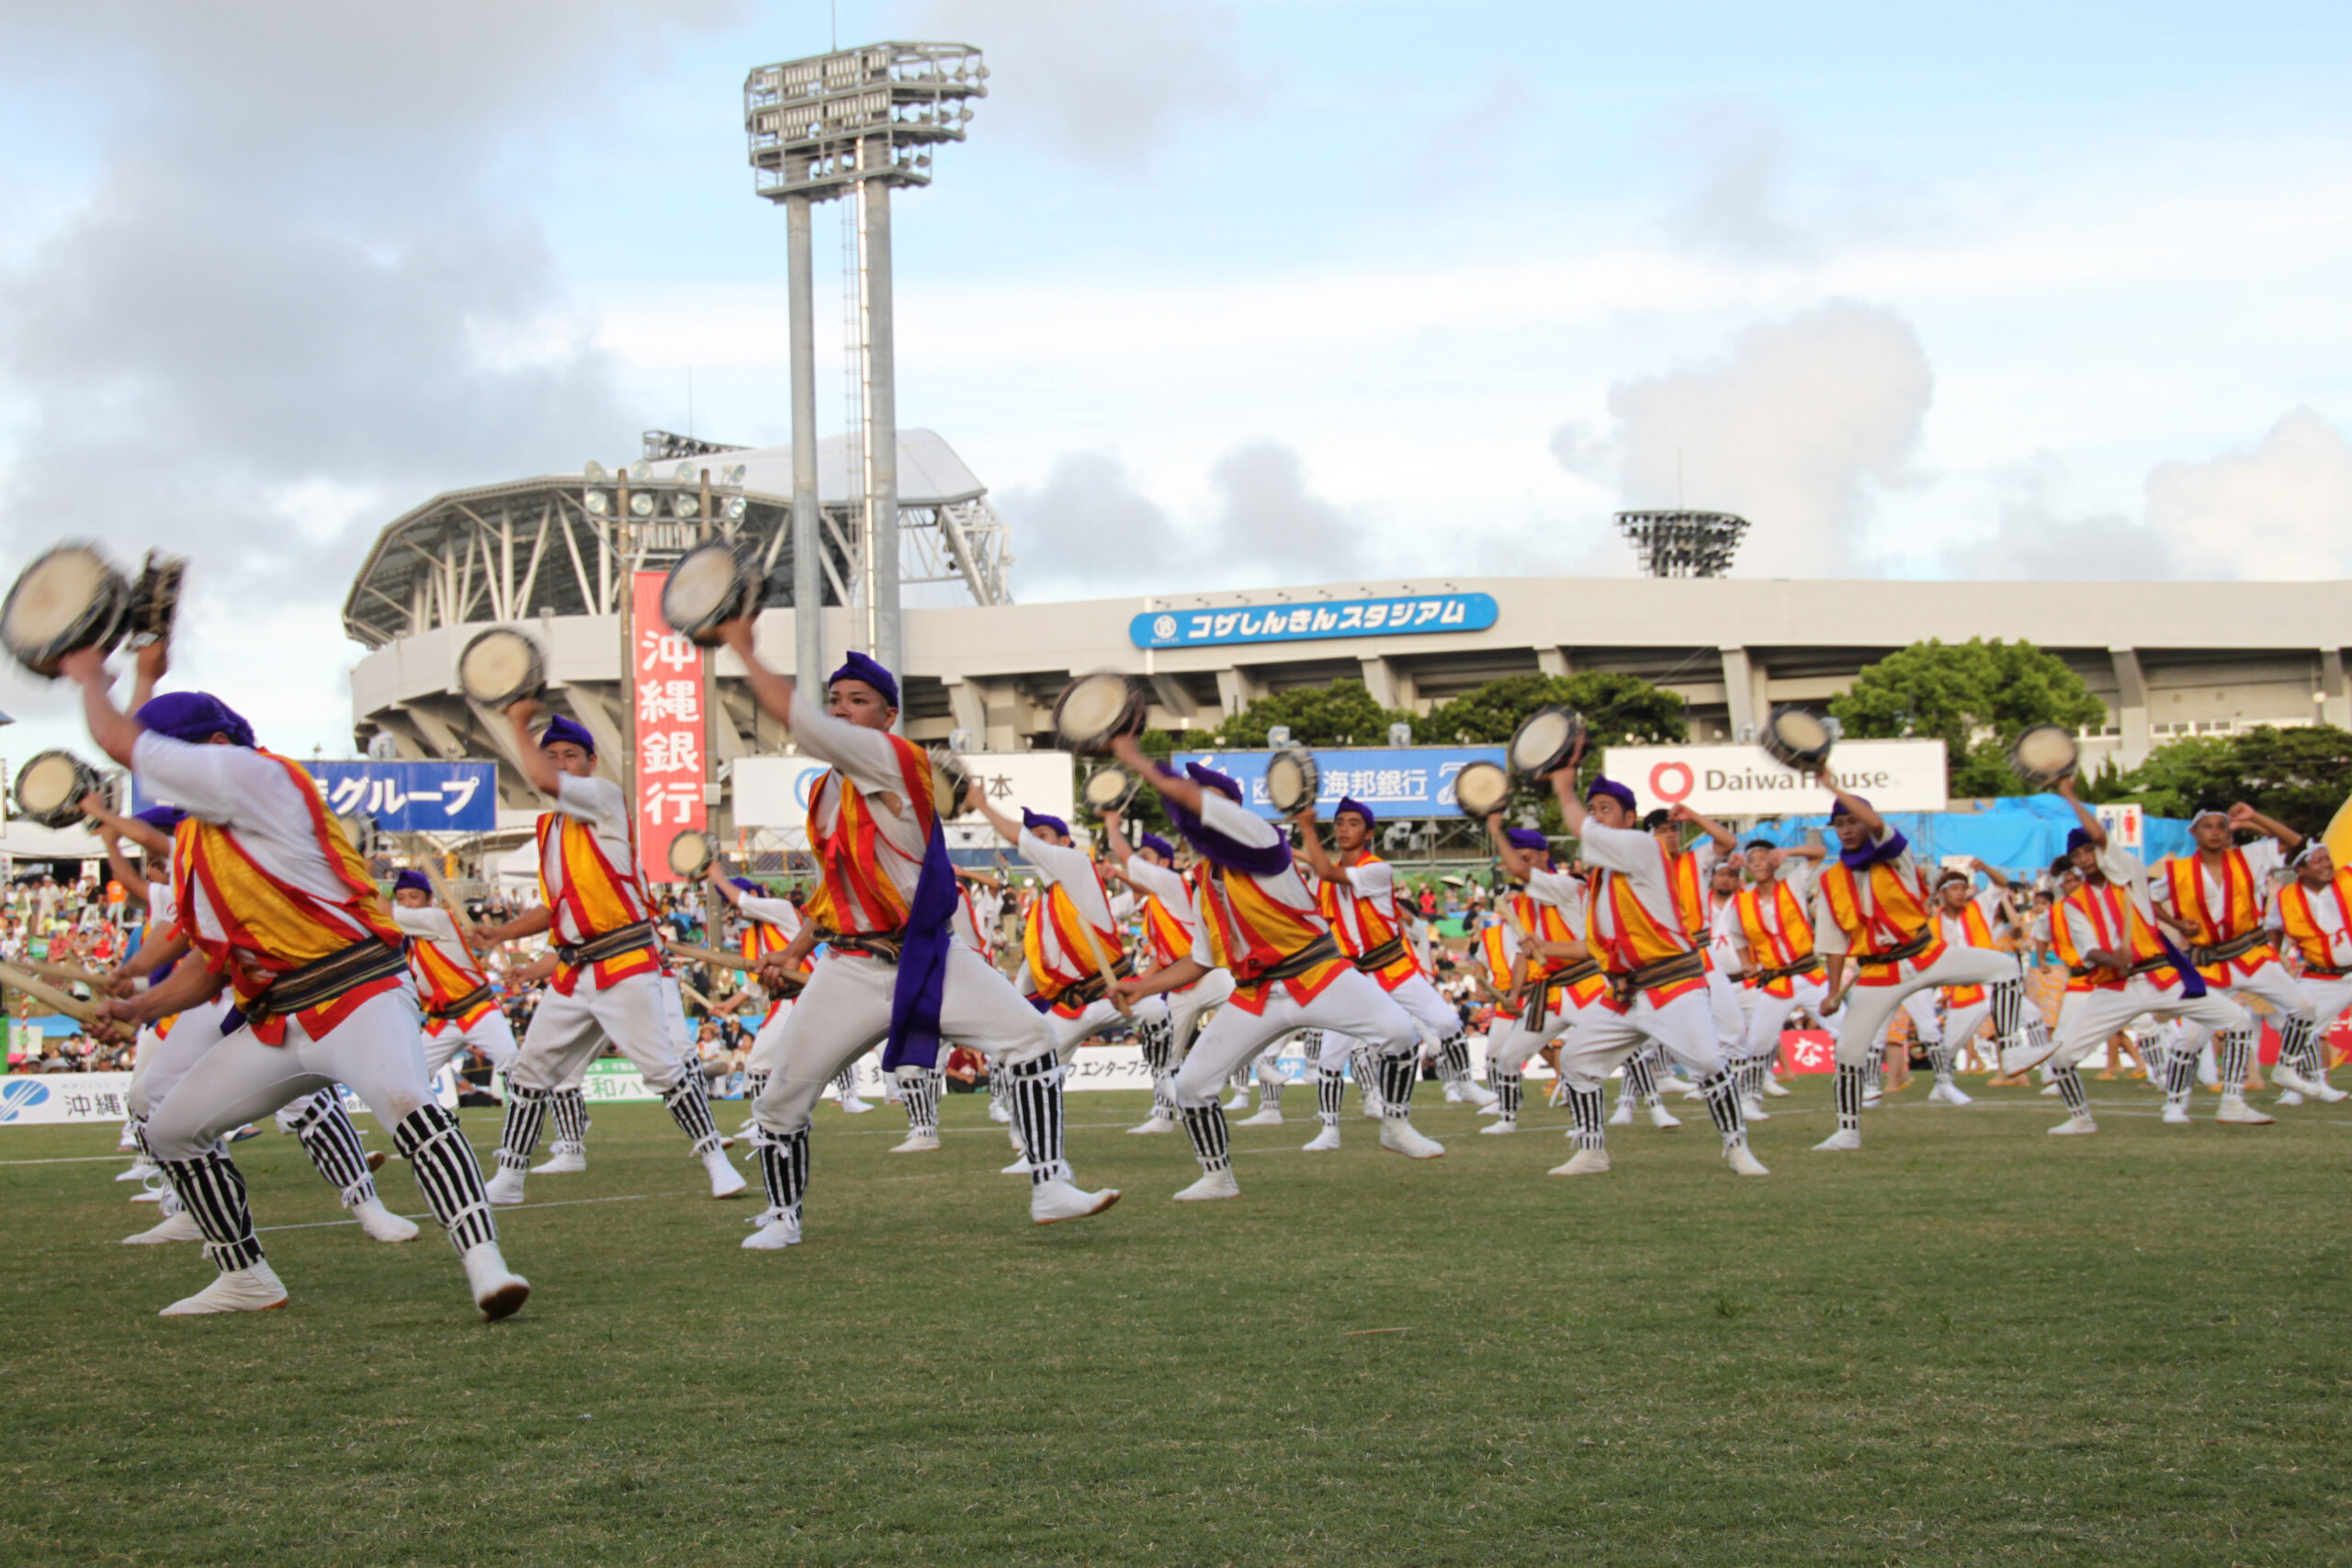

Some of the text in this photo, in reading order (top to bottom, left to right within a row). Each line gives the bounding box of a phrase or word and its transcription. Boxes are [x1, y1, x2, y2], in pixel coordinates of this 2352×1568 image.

[1188, 601, 1465, 638] コザしんきんスタジアム
[639, 630, 699, 825] 沖縄銀行
[314, 776, 481, 816] グループ
[1323, 769, 1429, 796] 海邦銀行
[1705, 769, 1791, 791] Daiwa
[64, 1093, 130, 1117] 沖縄
